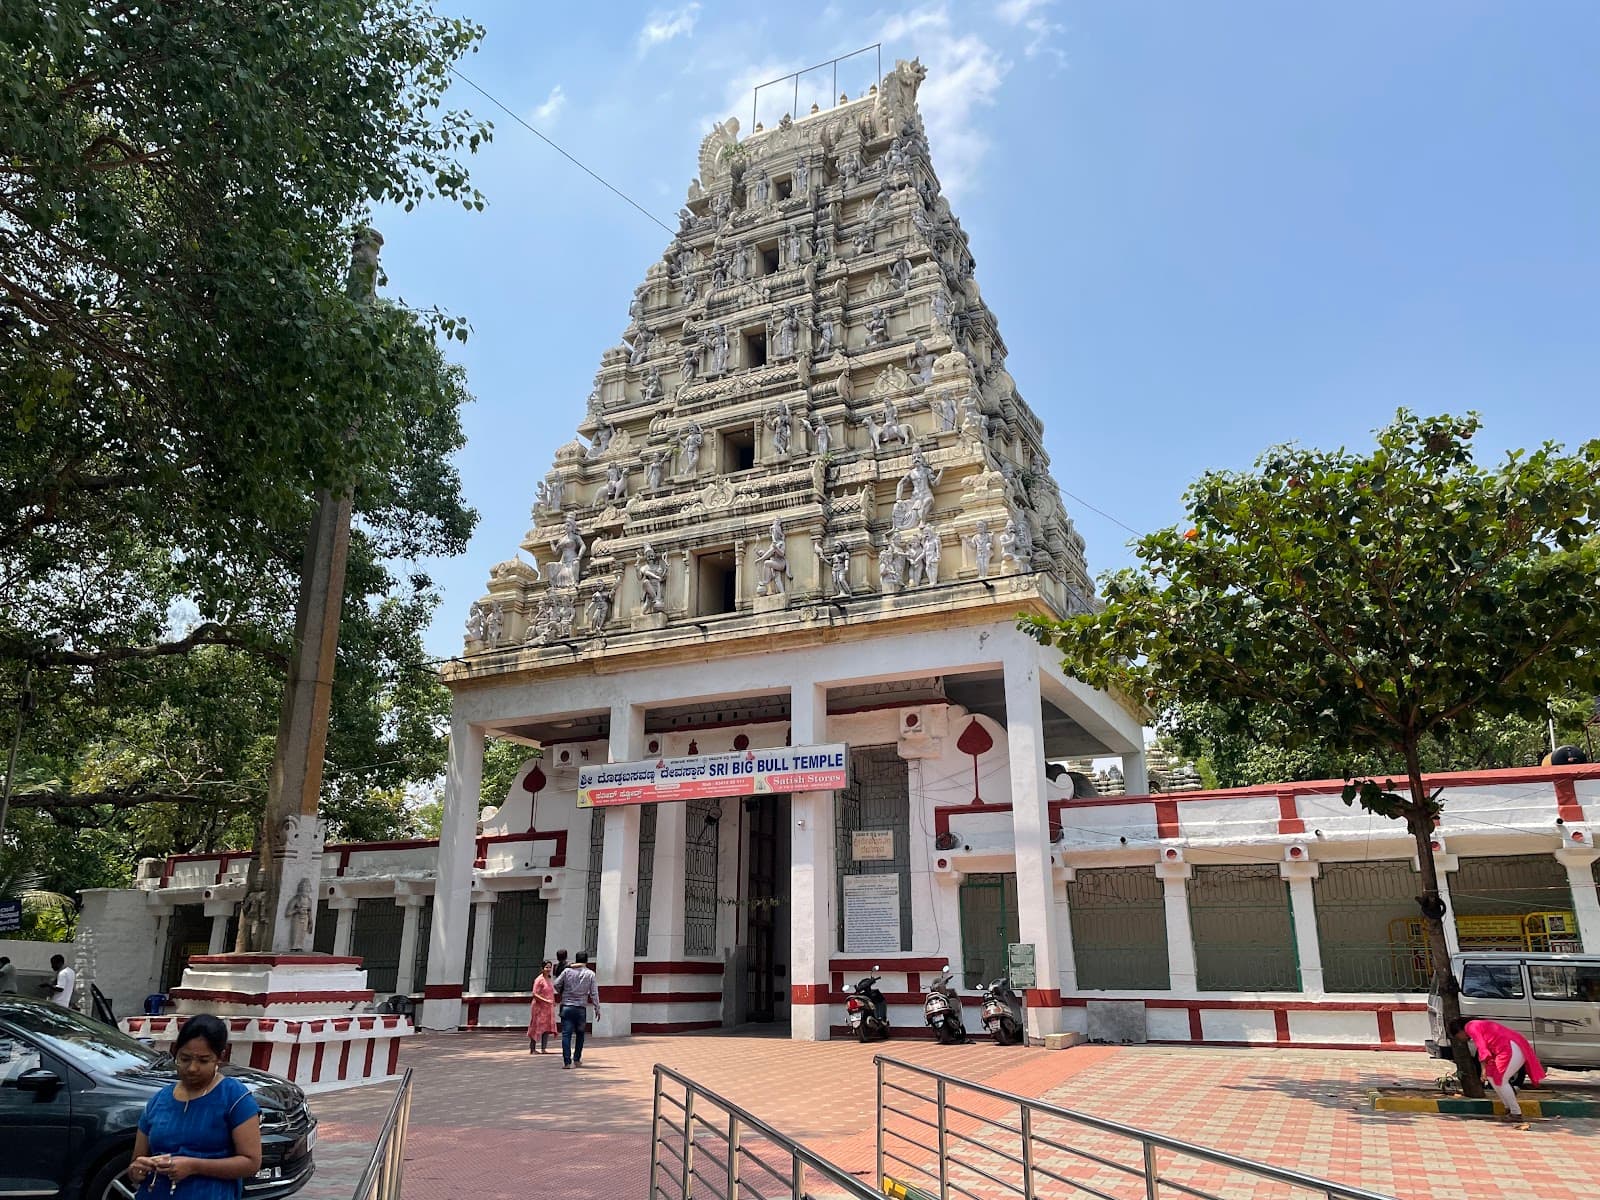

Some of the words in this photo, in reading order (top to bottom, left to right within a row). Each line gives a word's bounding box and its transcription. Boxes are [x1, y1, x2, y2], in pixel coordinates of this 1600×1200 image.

[709, 762, 729, 777] SRI
[732, 760, 753, 775] BIG
[757, 758, 789, 773] BULL
[793, 753, 843, 770] TEMPLE
[773, 775, 805, 786] Satish
[807, 774, 841, 784] Stores
